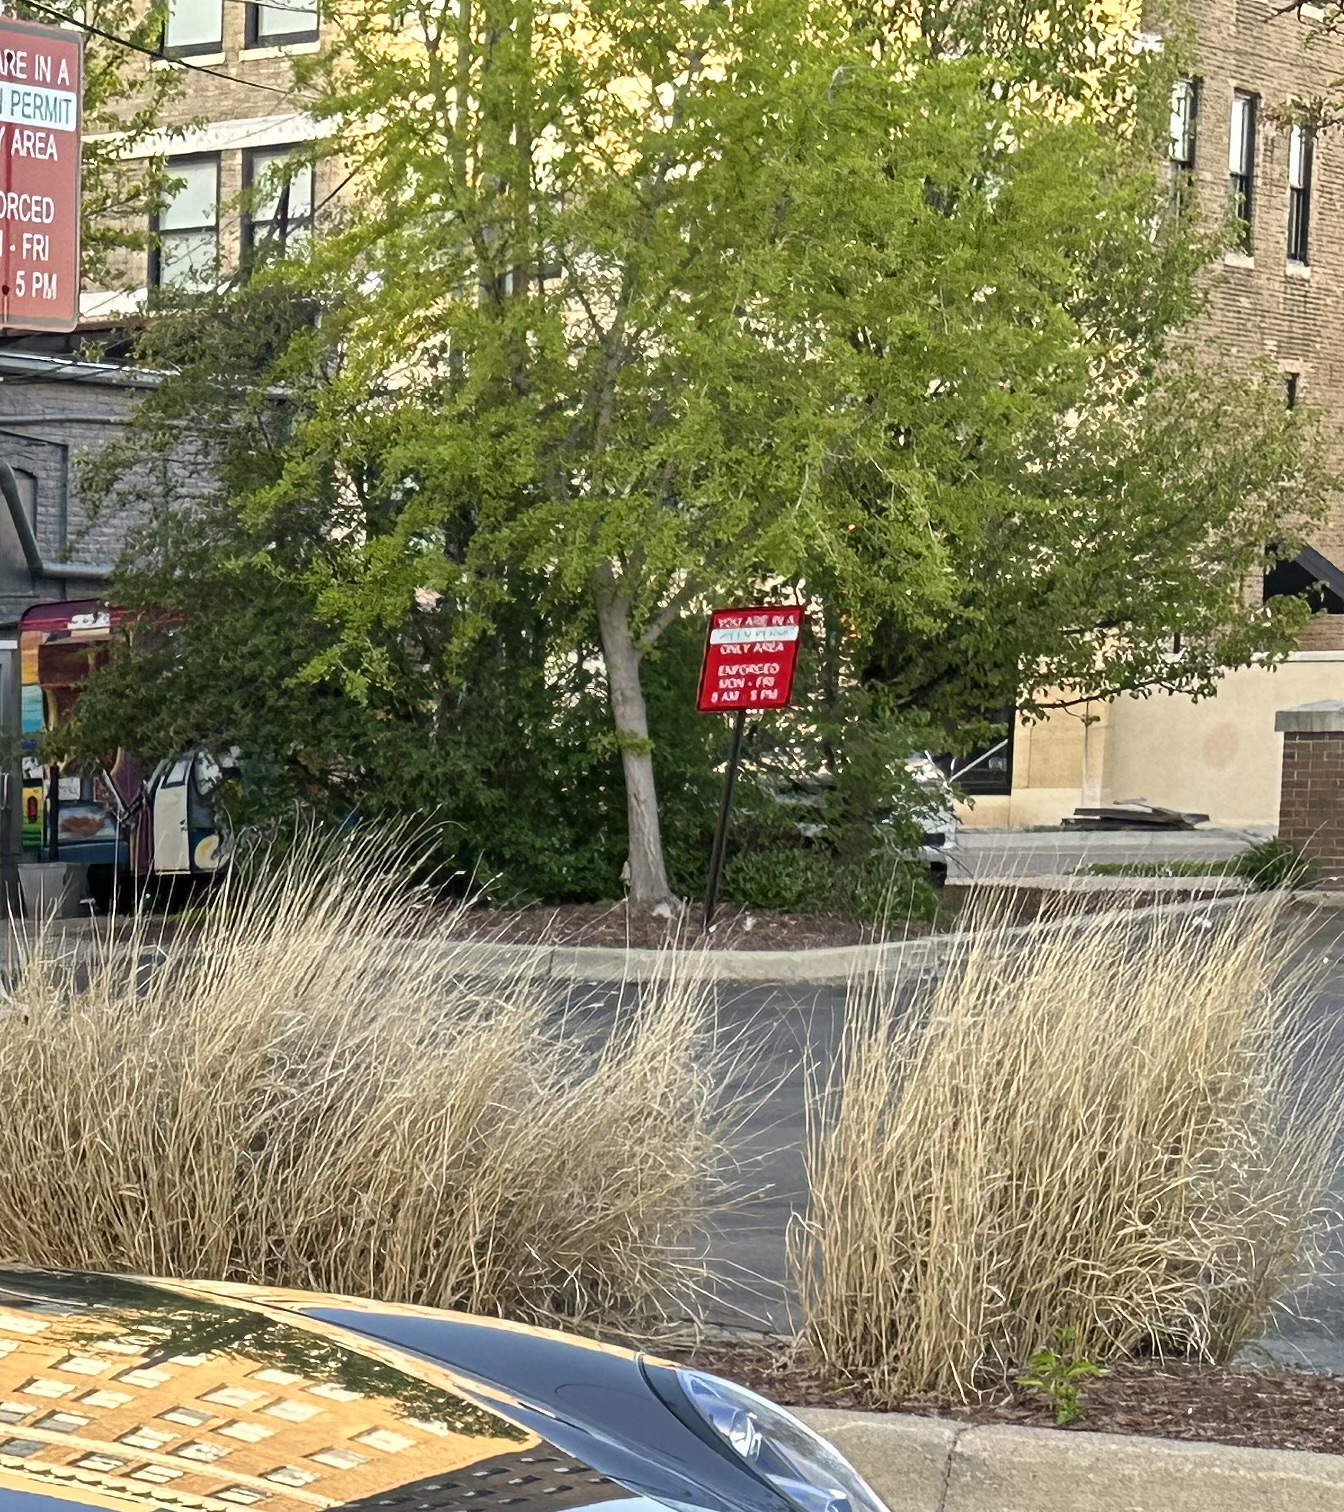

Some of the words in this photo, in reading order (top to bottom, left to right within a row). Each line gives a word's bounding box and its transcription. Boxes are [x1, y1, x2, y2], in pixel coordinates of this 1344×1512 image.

[35, 54, 52, 83] IN
[58, 59, 70, 86] A
[11, 90, 72, 125] PERMIT
[11, 129, 58, 161] AREA
[22, 233, 49, 262] FRI
[15, 271, 26, 298] 5
[32, 271, 58, 300] PM
[720, 644, 751, 655] ONLY
